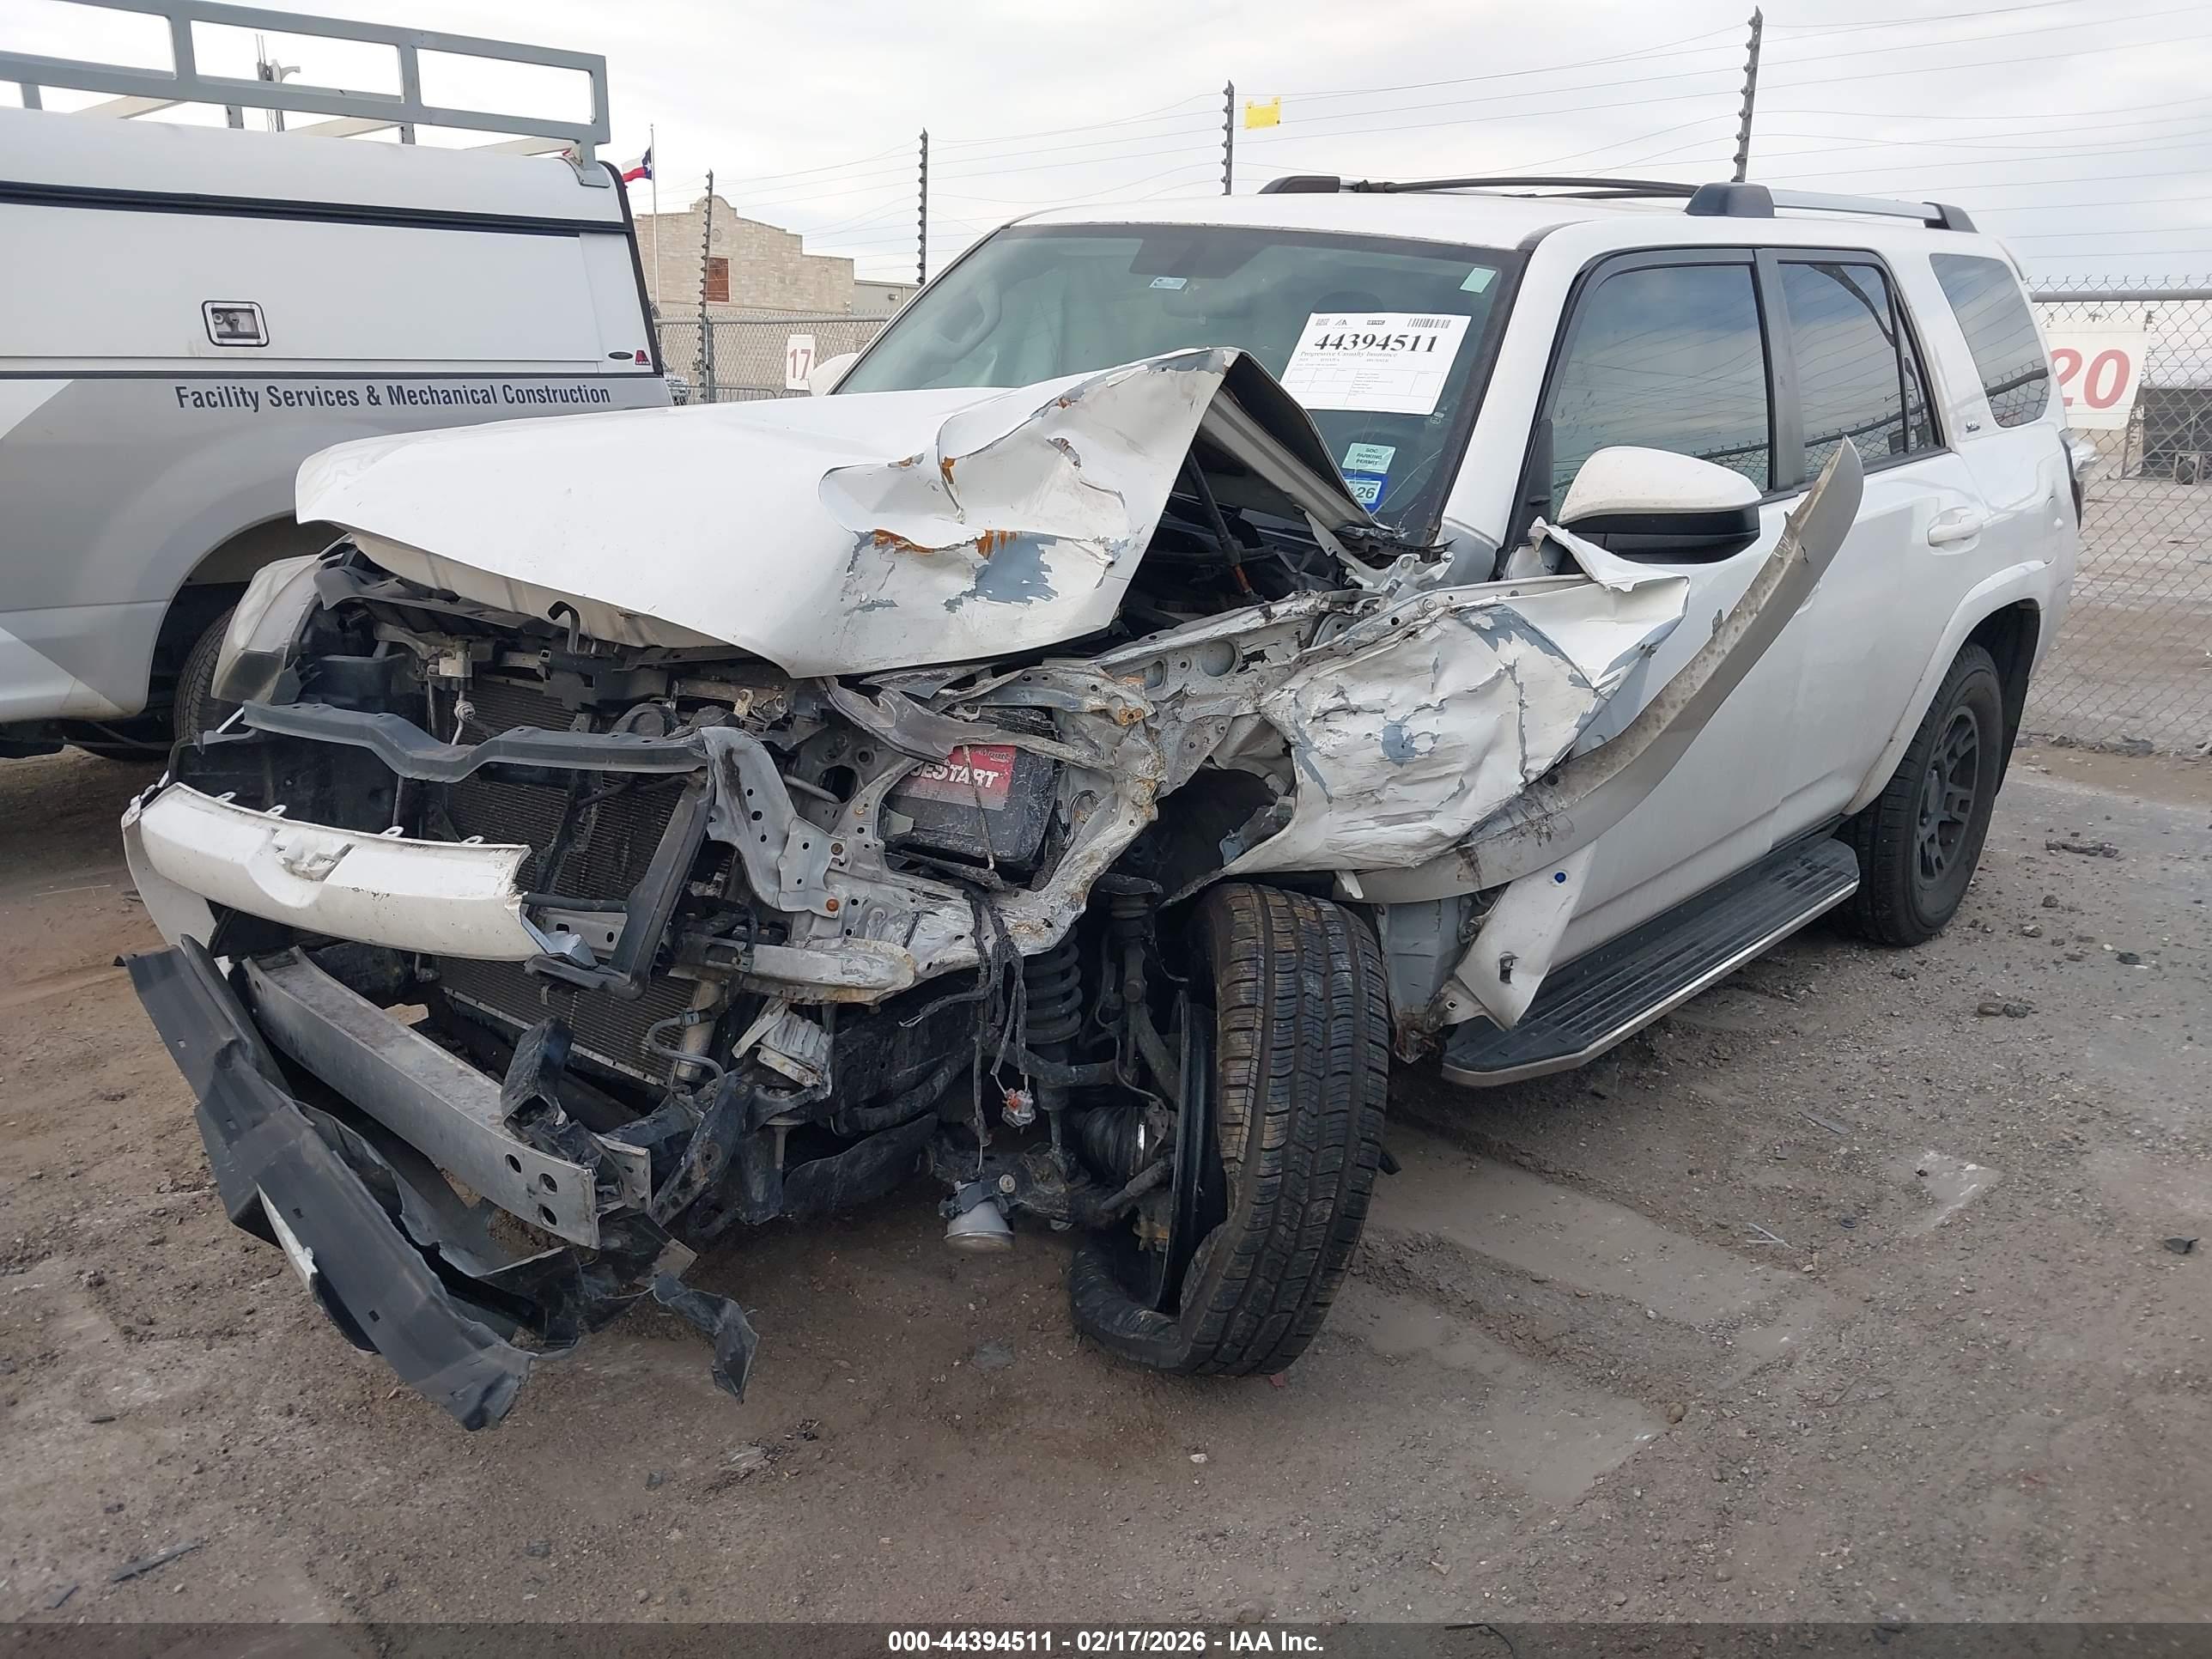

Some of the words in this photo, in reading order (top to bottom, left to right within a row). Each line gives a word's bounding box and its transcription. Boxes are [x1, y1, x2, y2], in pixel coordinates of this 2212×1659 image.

[1314, 333, 1438, 353] 44394511
[789, 349, 811, 380] 17
[2050, 348, 2130, 409] 20
[174, 386, 259, 413] Facility
[266, 385, 361, 408] Services
[367, 385, 383, 406] &
[386, 385, 498, 406] Mechanical
[501, 384, 611, 405] Construction
[1356, 487, 1376, 499] 26
